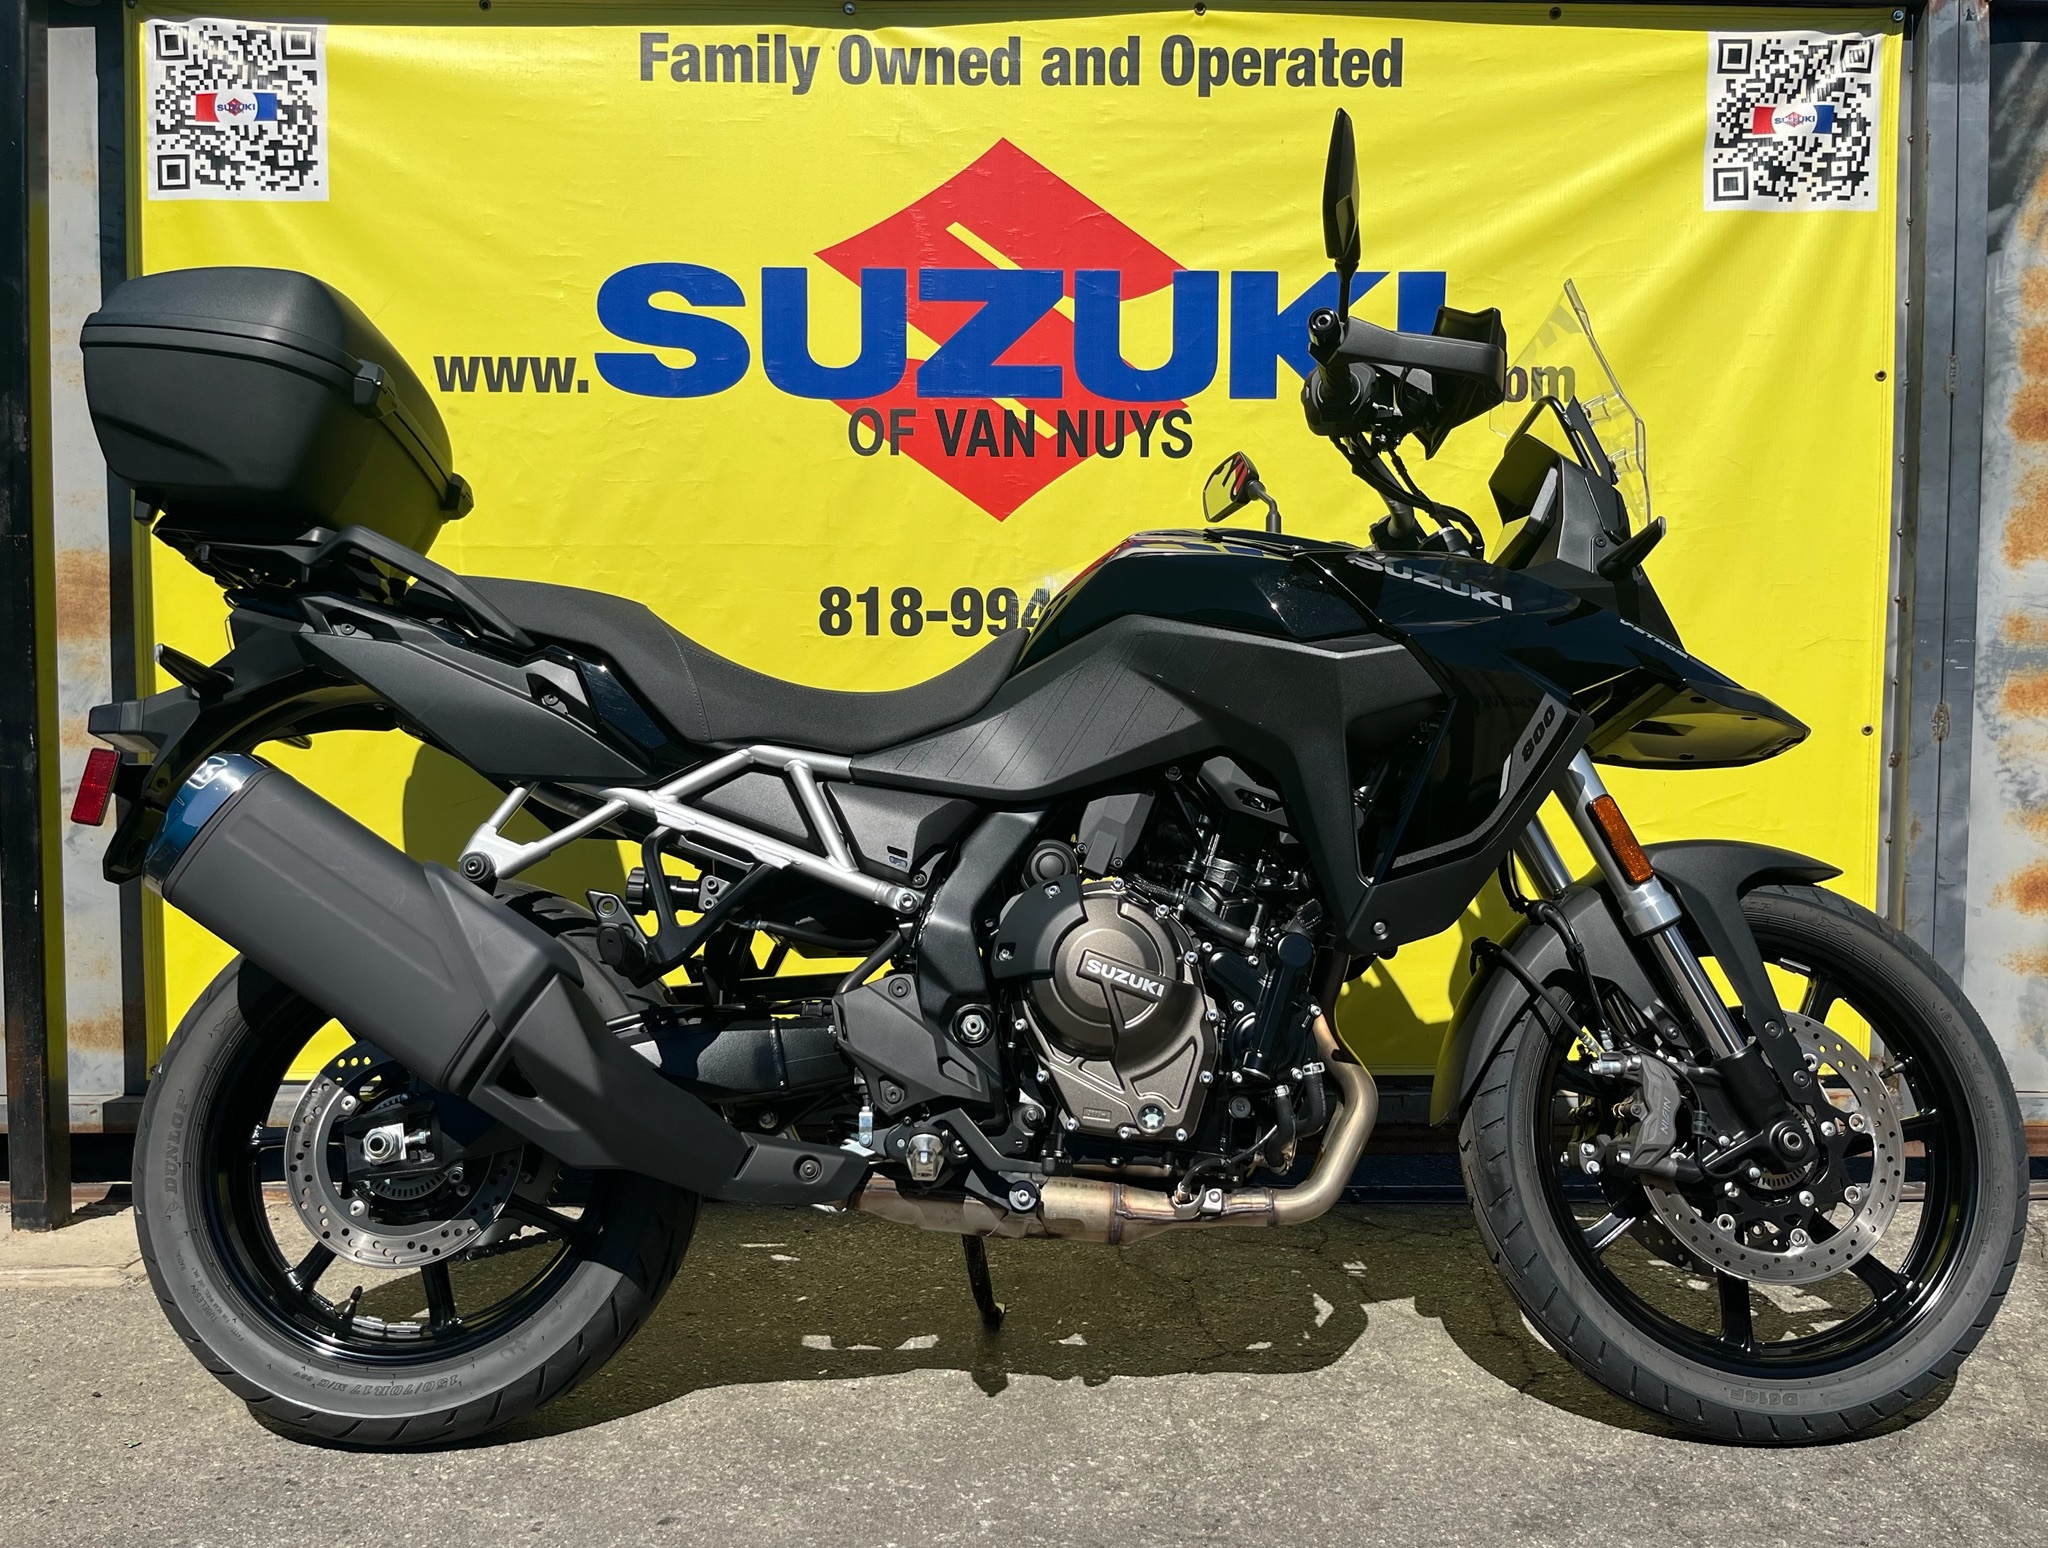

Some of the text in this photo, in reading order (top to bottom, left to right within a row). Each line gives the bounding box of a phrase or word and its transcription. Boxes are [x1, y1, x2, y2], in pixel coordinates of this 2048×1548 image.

[640, 33, 1404, 98] Family Owned and Operated
[217, 103, 256, 112] SUZUKI
[433, 356, 589, 394] www.
[849, 408, 1193, 459] OF VAN NUYS
[1346, 556, 1513, 612] SUZUKI
[1521, 704, 1556, 763] 800
[1086, 959, 1165, 997] SUZUKI
[164, 1093, 188, 1194] DUNLOP
